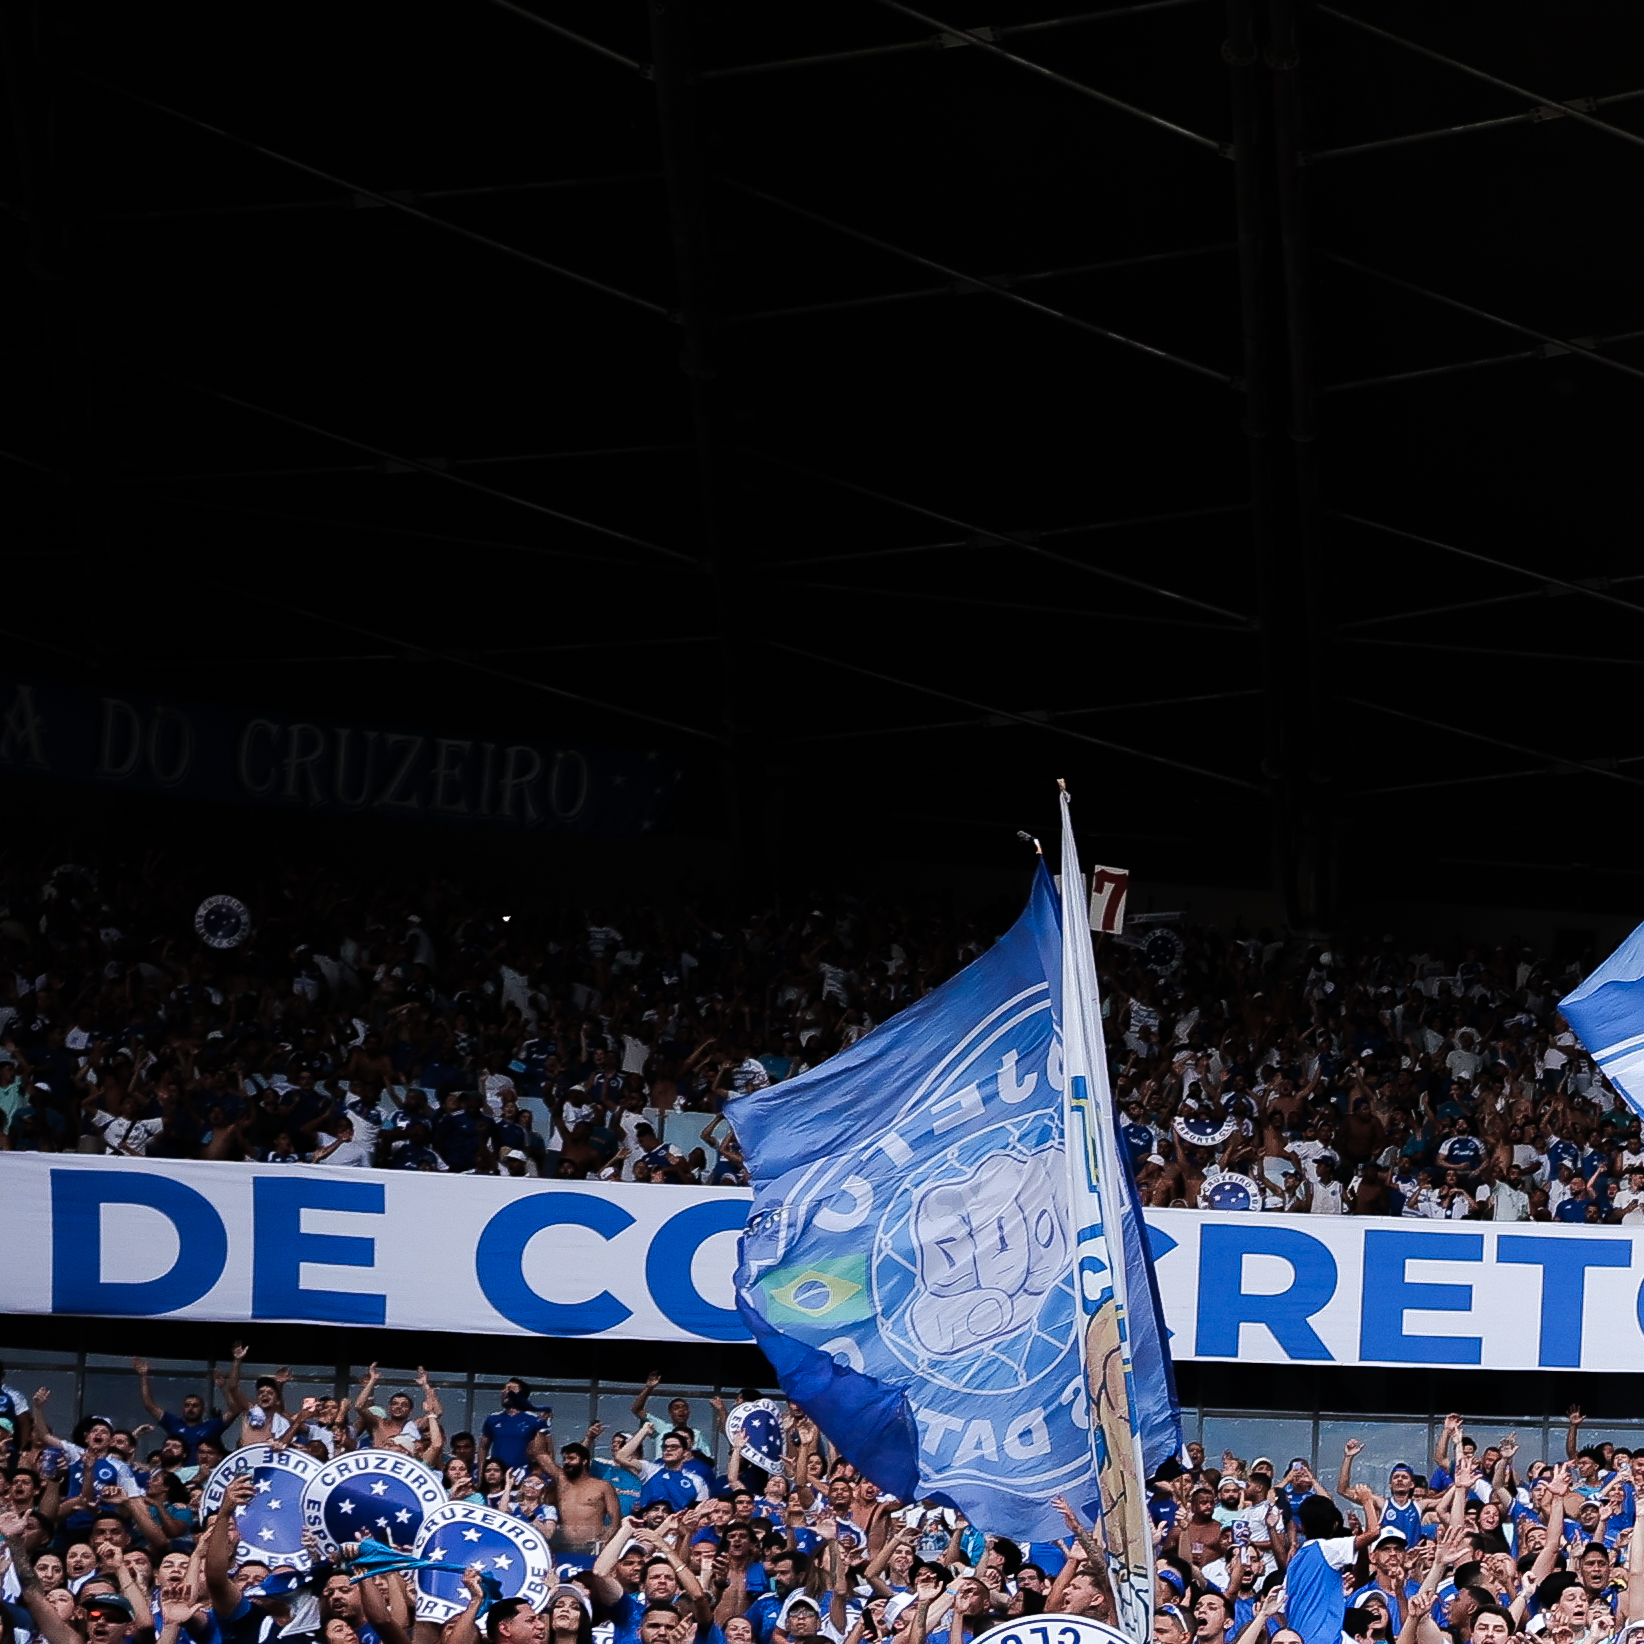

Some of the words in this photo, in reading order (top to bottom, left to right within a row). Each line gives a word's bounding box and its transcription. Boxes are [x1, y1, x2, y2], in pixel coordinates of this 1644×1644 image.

[94, 697, 197, 789] DO
[233, 716, 592, 828] CRUZEIRO
[1094, 869, 1128, 932] 7
[52, 1168, 387, 1318] DE
[321, 1456, 438, 1504] CRUZEIRO
